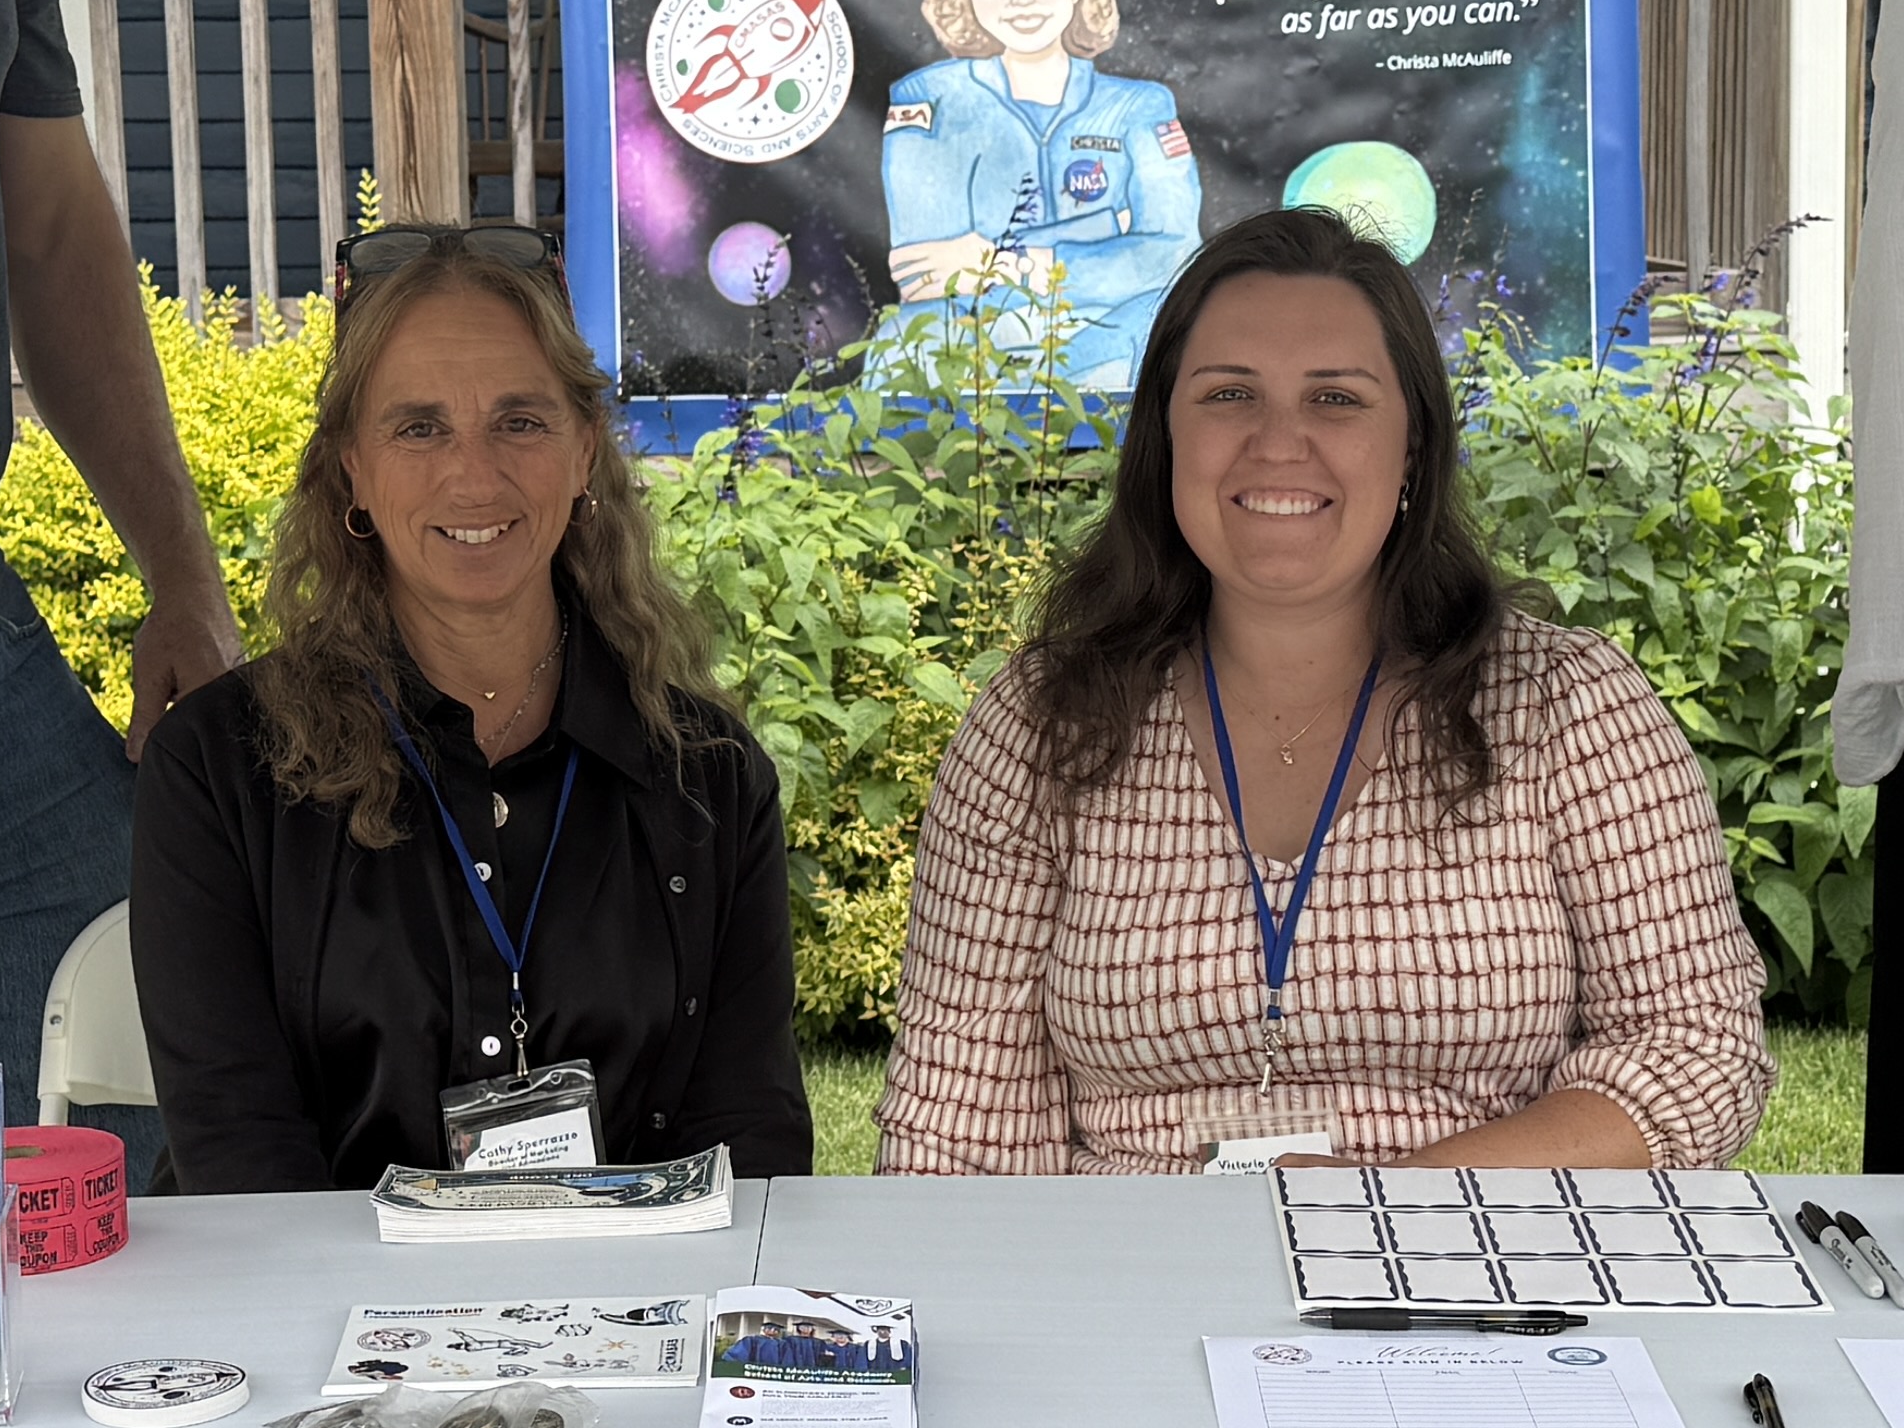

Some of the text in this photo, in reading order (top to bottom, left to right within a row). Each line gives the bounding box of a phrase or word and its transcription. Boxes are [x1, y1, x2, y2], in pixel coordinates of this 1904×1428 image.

[734, 1, 786, 49] CMASAS
[1281, 10, 1312, 34] as
[1315, 3, 1361, 39] far
[1367, 5, 1398, 29] as
[1402, 3, 1456, 34] you
[654, 33, 673, 103] CHRISTA
[1387, 53, 1439, 71] Christa
[1442, 49, 1512, 69] McAuliffe
[682, 10, 847, 157] SCHOOL OF ARTS AND SCIENCES
[1072, 138, 1121, 151] CHRISTA
[1070, 173, 1108, 191] NASA
[478, 1144, 513, 1160] Cathy
[84, 1167, 118, 1201] TICKET
[18, 1188, 59, 1214] CKET
[19, 1231, 48, 1245] KEEP
[19, 1251, 58, 1268] OUPON
